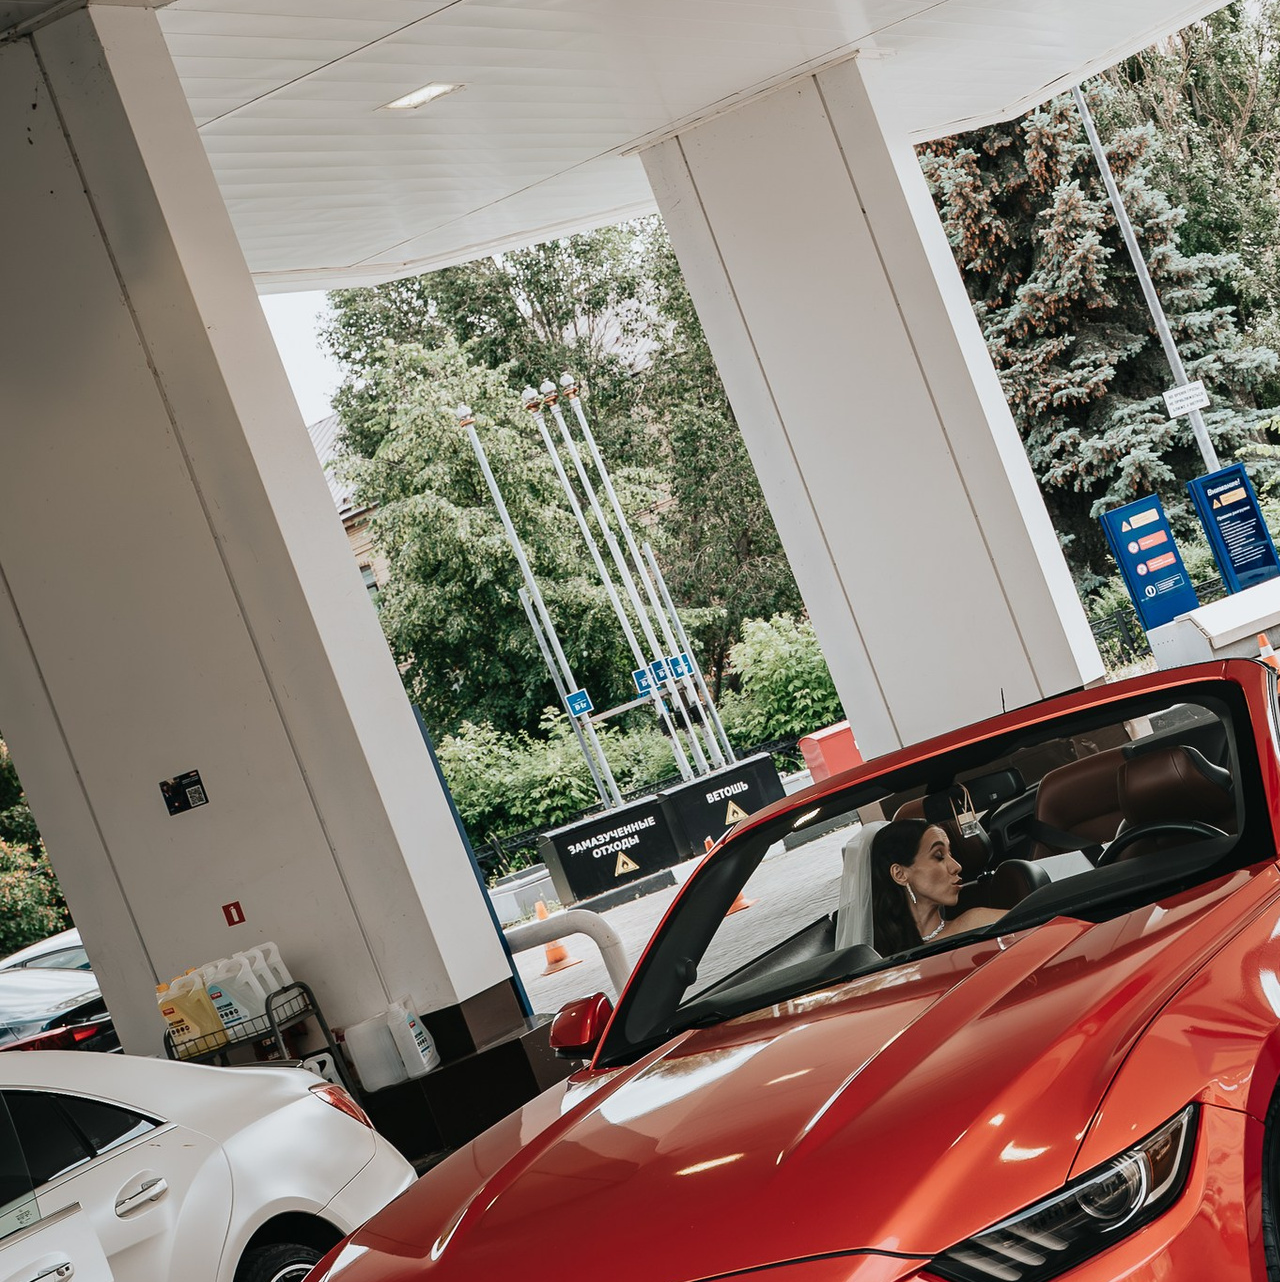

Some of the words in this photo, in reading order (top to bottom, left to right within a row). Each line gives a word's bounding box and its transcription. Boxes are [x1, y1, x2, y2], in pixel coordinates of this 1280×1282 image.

[705, 781, 749, 804] ВЕТОШЬ
[567, 816, 656, 855] ЗАМАЗУЧЕННЫЕ
[592, 835, 640, 859] ОТХОДЫ
